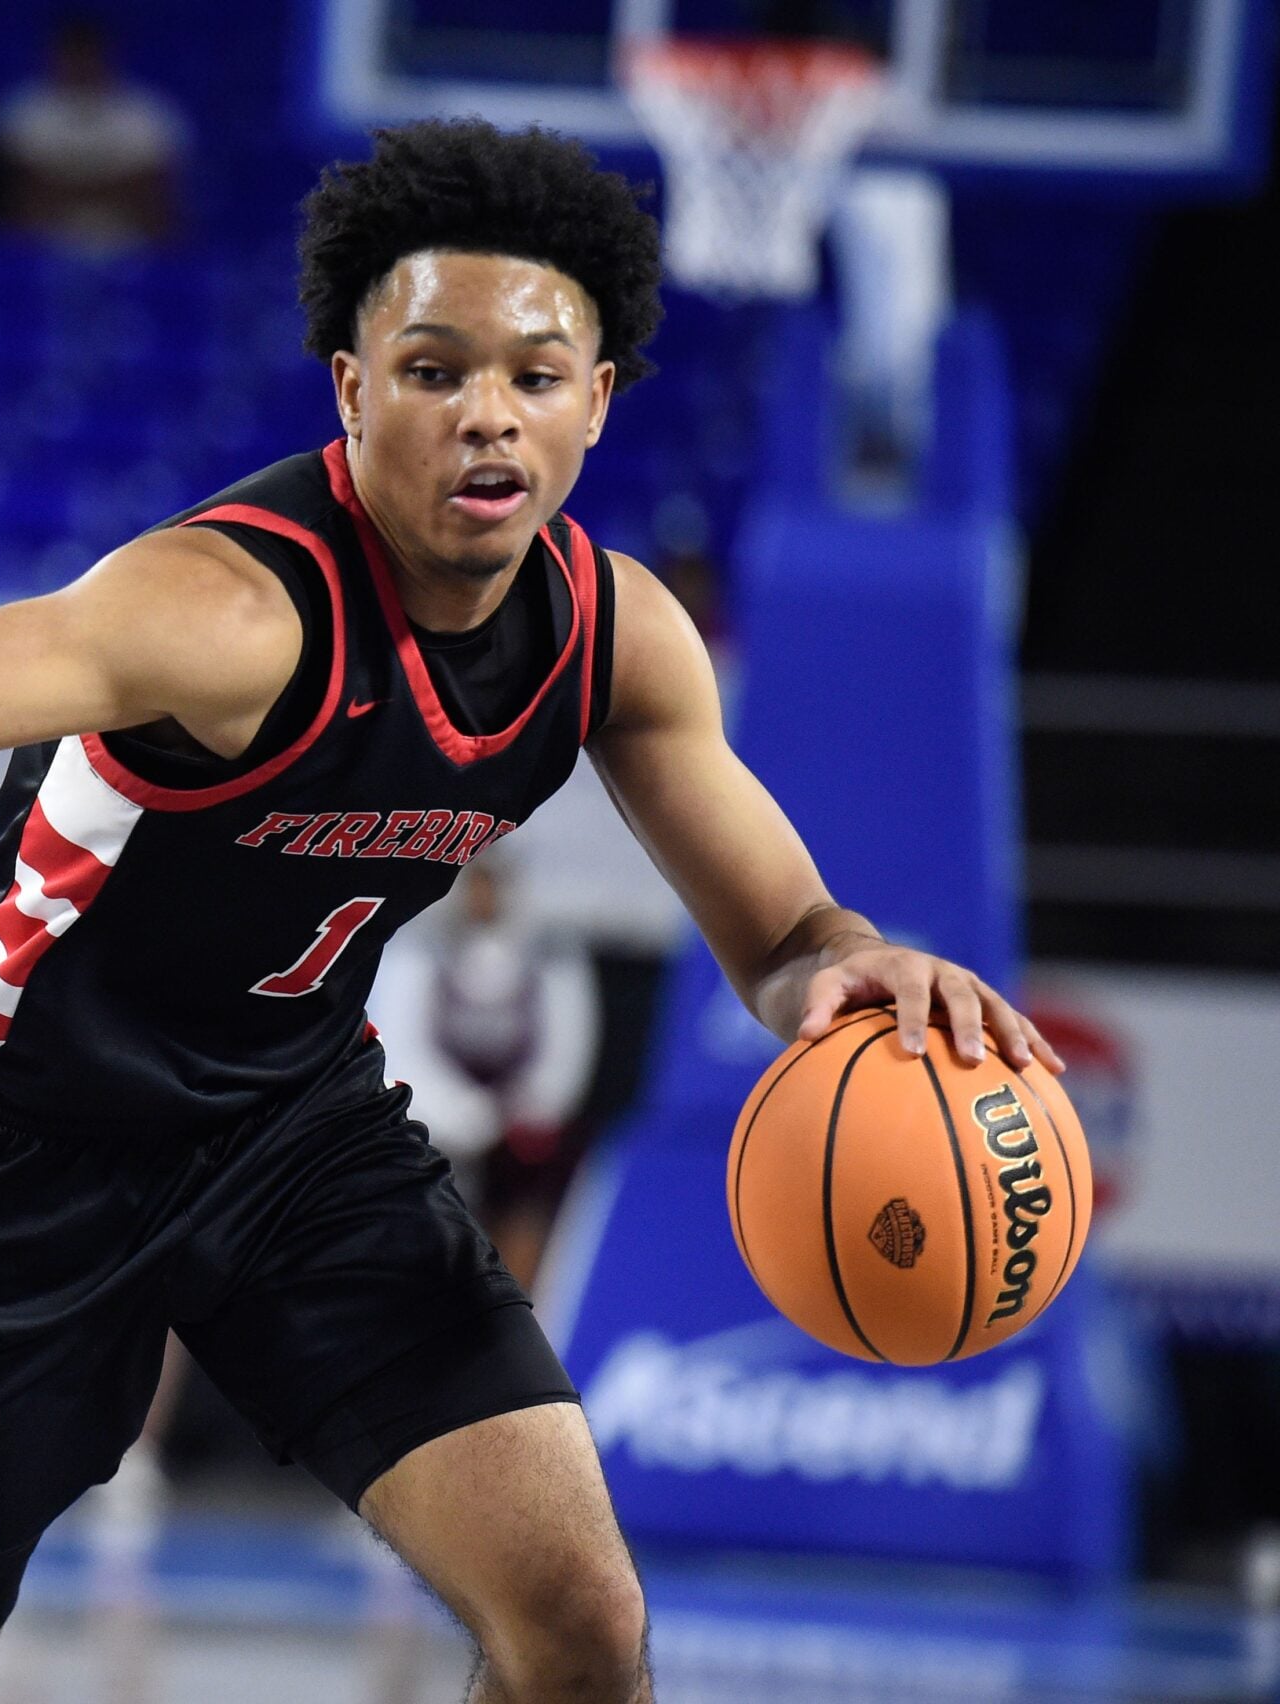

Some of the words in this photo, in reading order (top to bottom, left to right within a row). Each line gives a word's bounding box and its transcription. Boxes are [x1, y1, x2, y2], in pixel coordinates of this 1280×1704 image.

[248, 897, 386, 998] 1
[971, 1082, 1053, 1330] Wilson
[990, 1212, 999, 1244] GAME
[990, 1248, 999, 1276] BALL
